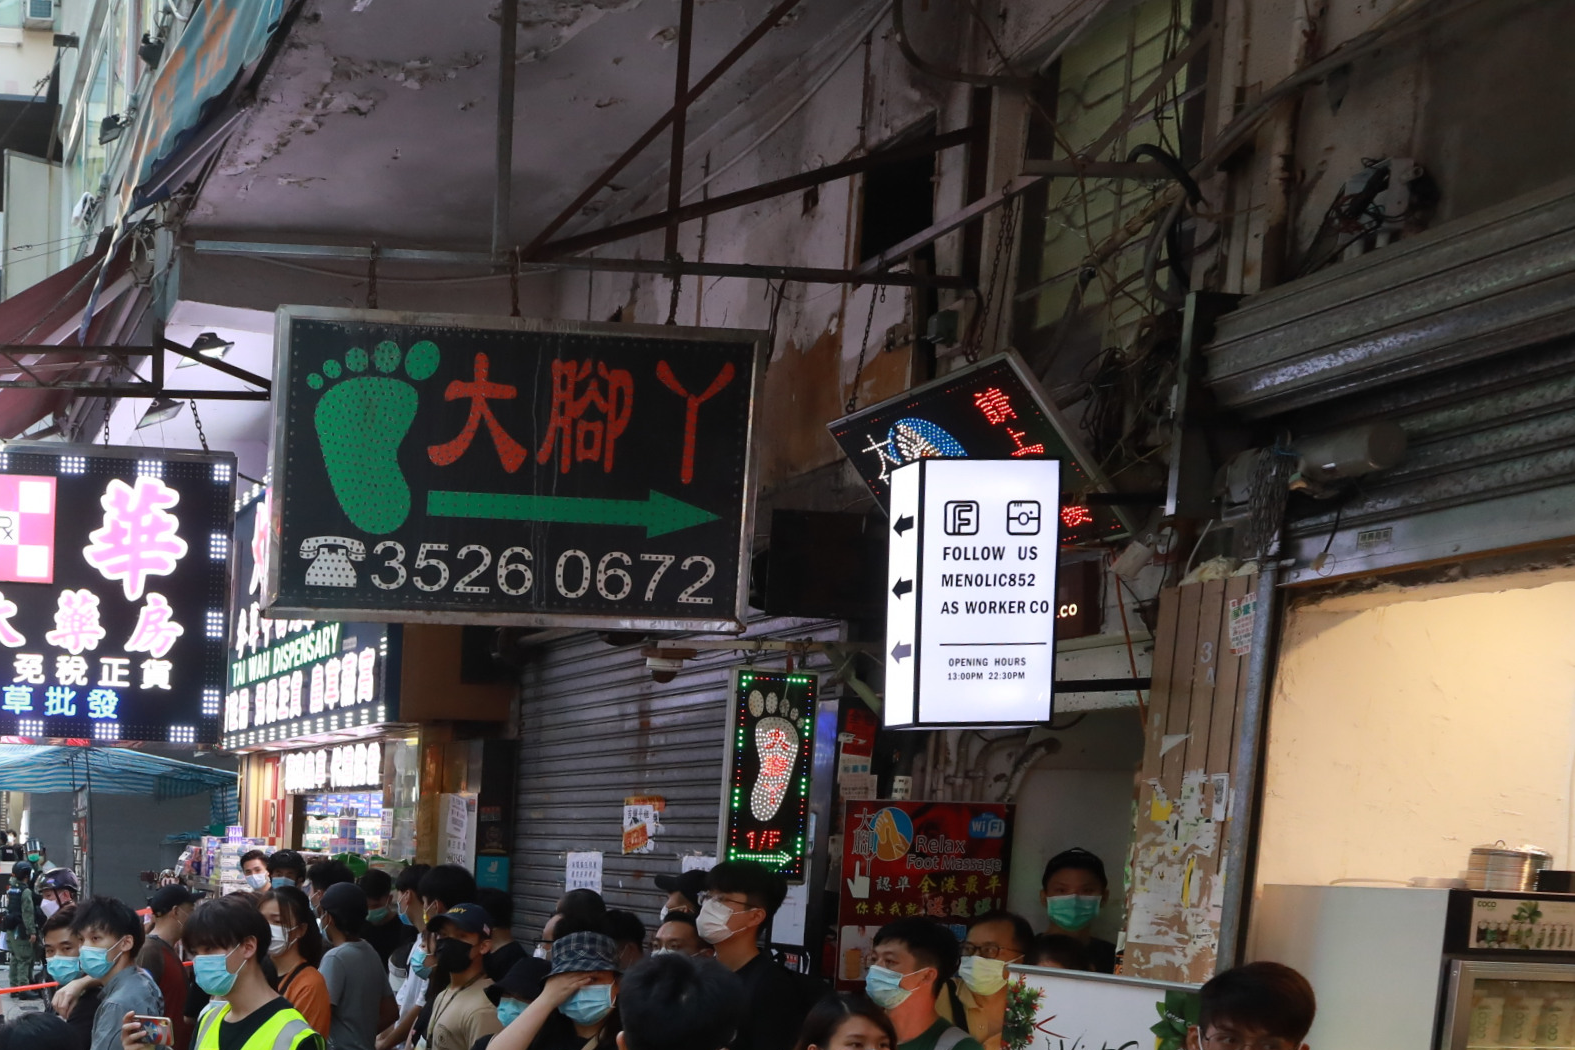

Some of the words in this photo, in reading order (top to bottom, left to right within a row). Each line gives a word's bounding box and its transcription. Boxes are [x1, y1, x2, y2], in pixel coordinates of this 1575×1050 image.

[427, 352, 735, 485] 大腳丫
[943, 546, 1005, 561] FOLLOW
[1018, 546, 1038, 561] US
[370, 540, 533, 596] 3526
[555, 548, 716, 605] 0672
[941, 573, 1036, 587] MENOLIC852
[940, 601, 959, 614] AS
[965, 601, 1025, 614] WORKER
[1029, 600, 1049, 614] CO
[232, 660, 246, 687] TAI
[248, 651, 270, 682] WAH
[273, 622, 340, 674] DISPENSARY
[948, 658, 989, 667] OPENING
[994, 657, 1027, 666] HOURS
[988, 672, 1025, 680] 22:30PM
[915, 835, 966, 853] Relax
[906, 854, 939, 870] Foot
[940, 856, 1002, 875] Massage
